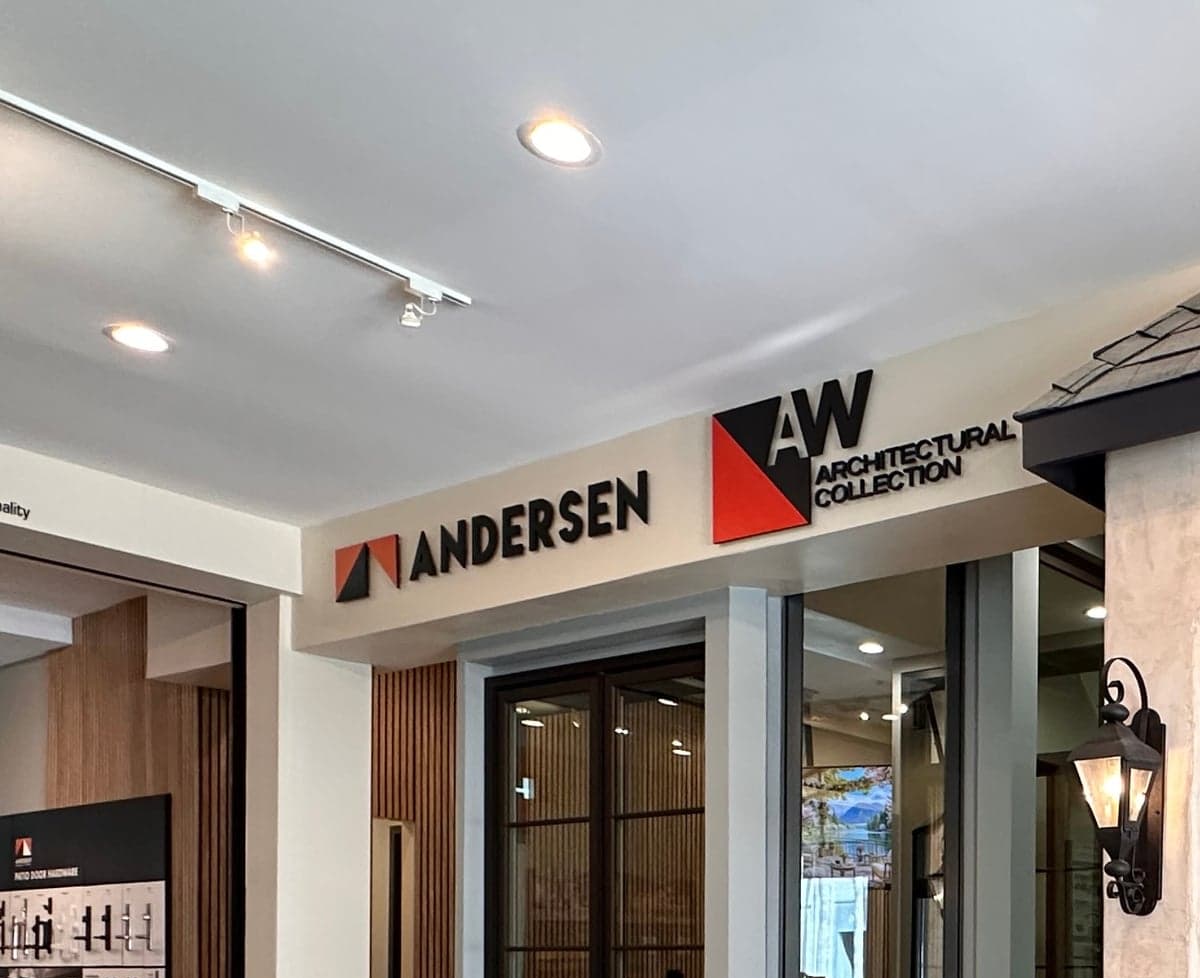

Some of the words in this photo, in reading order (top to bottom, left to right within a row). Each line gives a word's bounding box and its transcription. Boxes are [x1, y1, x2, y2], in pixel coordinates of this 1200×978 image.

[814, 419, 1017, 485] ARCHITECTURAL
[814, 455, 963, 508] COLLECTION
[0, 501, 31, 521] ality
[409, 470, 649, 581] ANDERSEN
